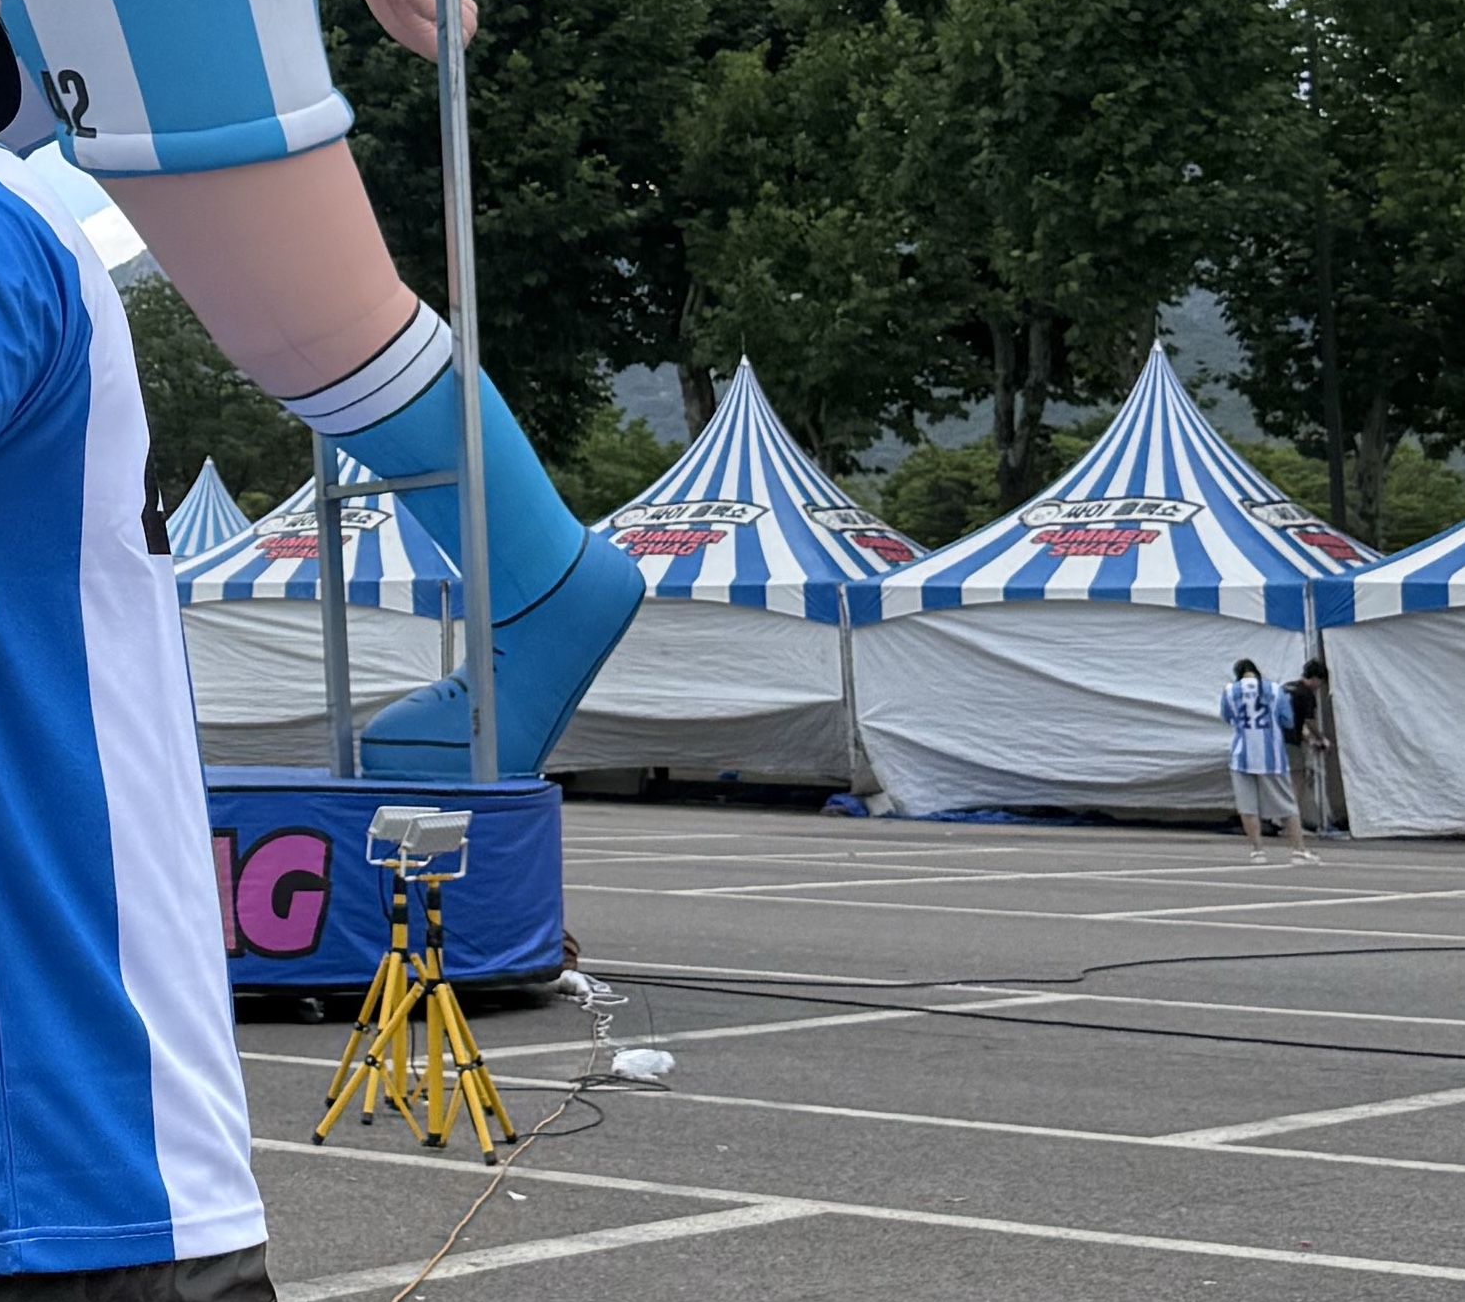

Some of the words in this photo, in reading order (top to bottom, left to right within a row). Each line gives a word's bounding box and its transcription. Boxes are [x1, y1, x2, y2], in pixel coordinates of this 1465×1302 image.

[1062, 502, 1112, 519] 싸이
[616, 529, 728, 544] SUMMER
[1031, 529, 1161, 544] SUMMER
[628, 543, 699, 555] SWAG
[1048, 543, 1128, 556] SWAG
